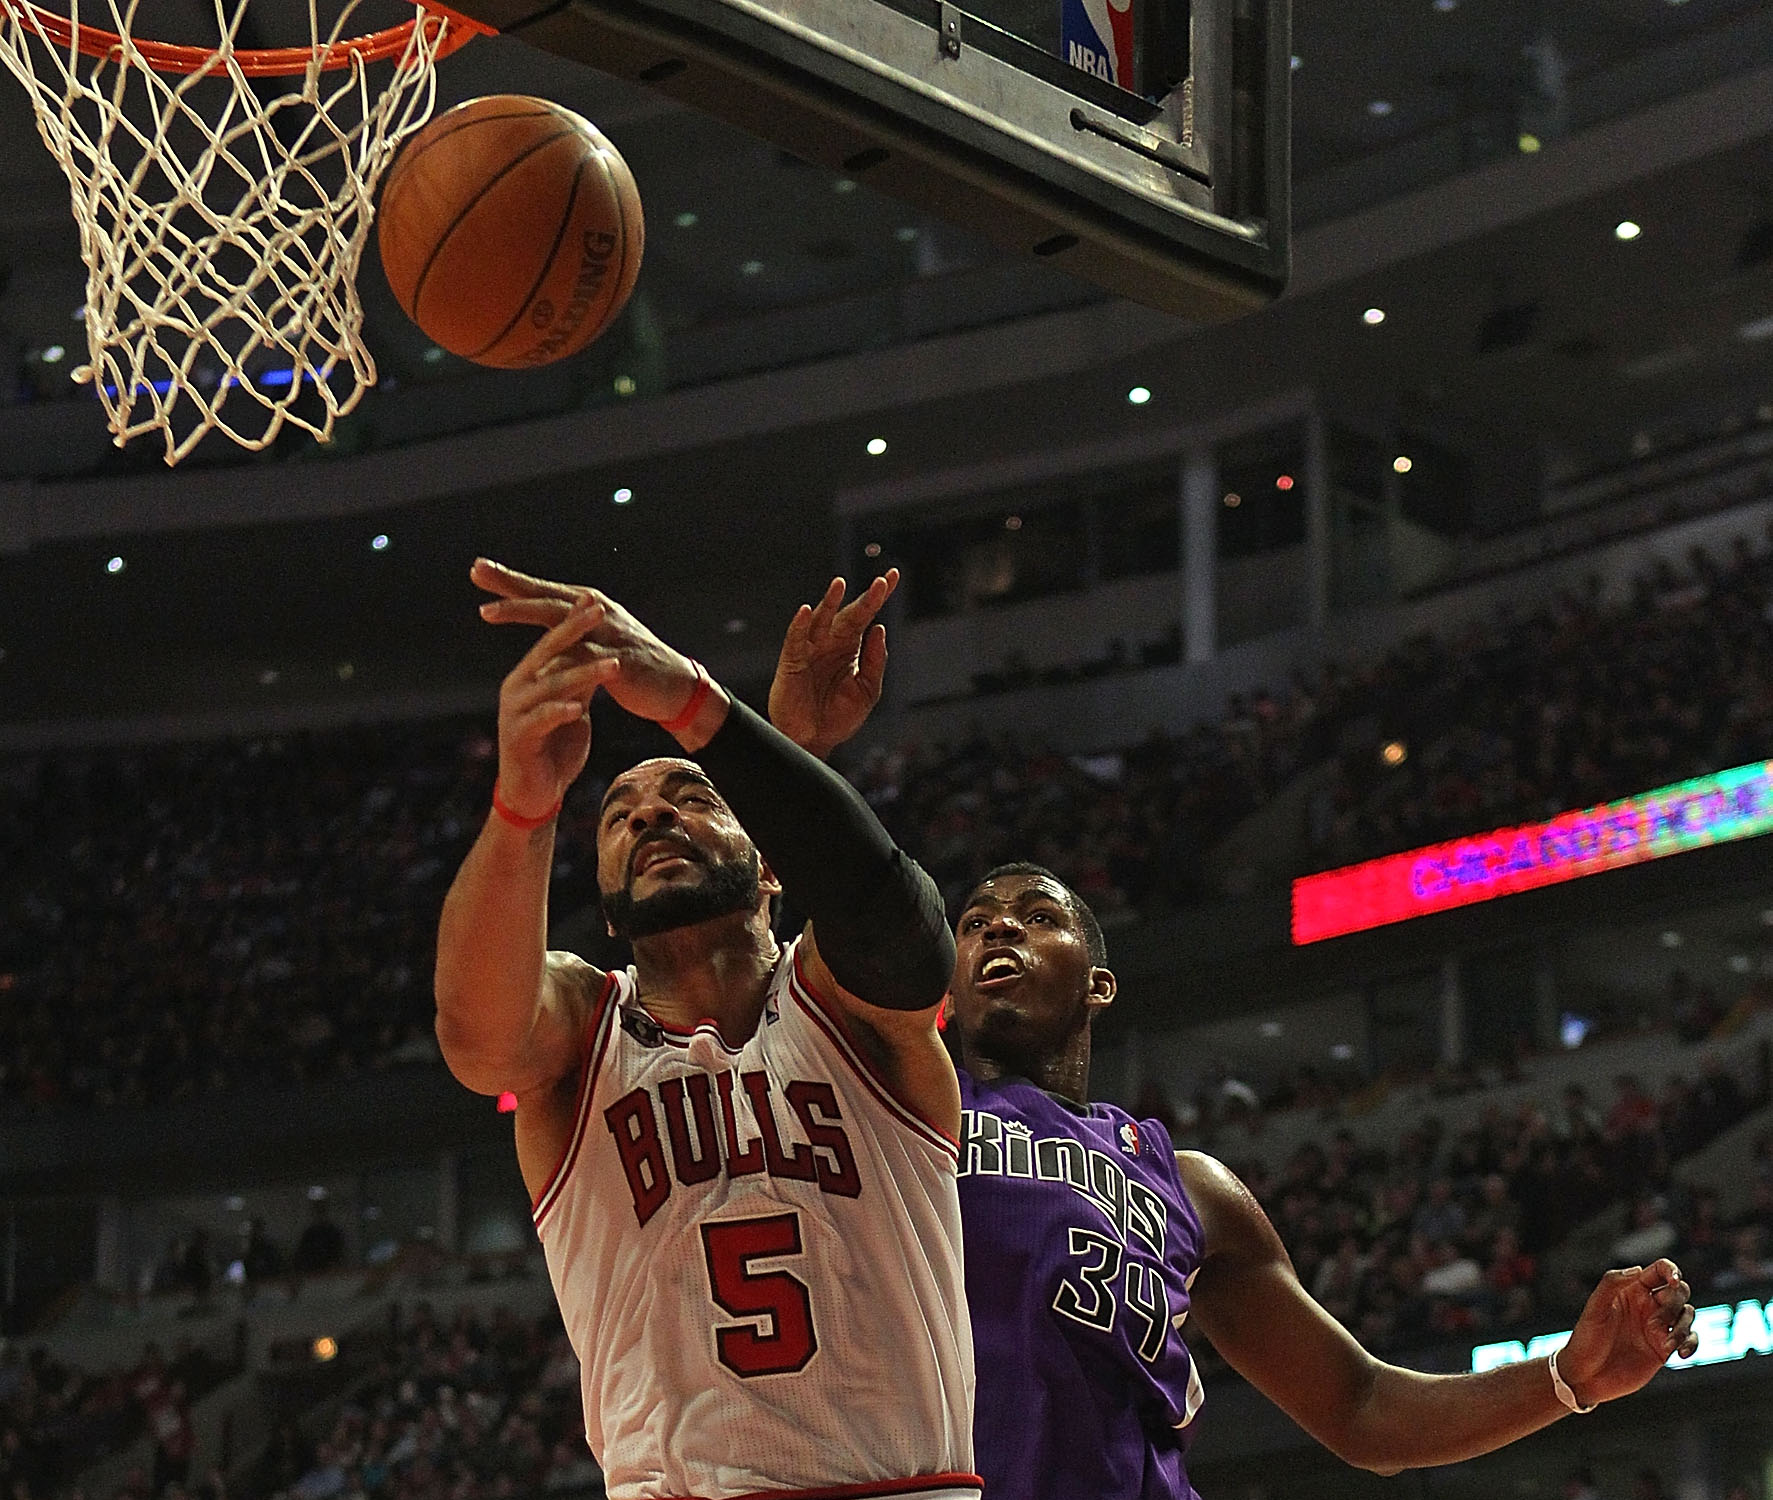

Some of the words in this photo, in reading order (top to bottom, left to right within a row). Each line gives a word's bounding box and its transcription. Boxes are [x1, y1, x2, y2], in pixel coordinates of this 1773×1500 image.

[603, 1070, 862, 1229] BULLS
[700, 1212, 818, 1379] 5
[1052, 1227, 1170, 1363] 34
